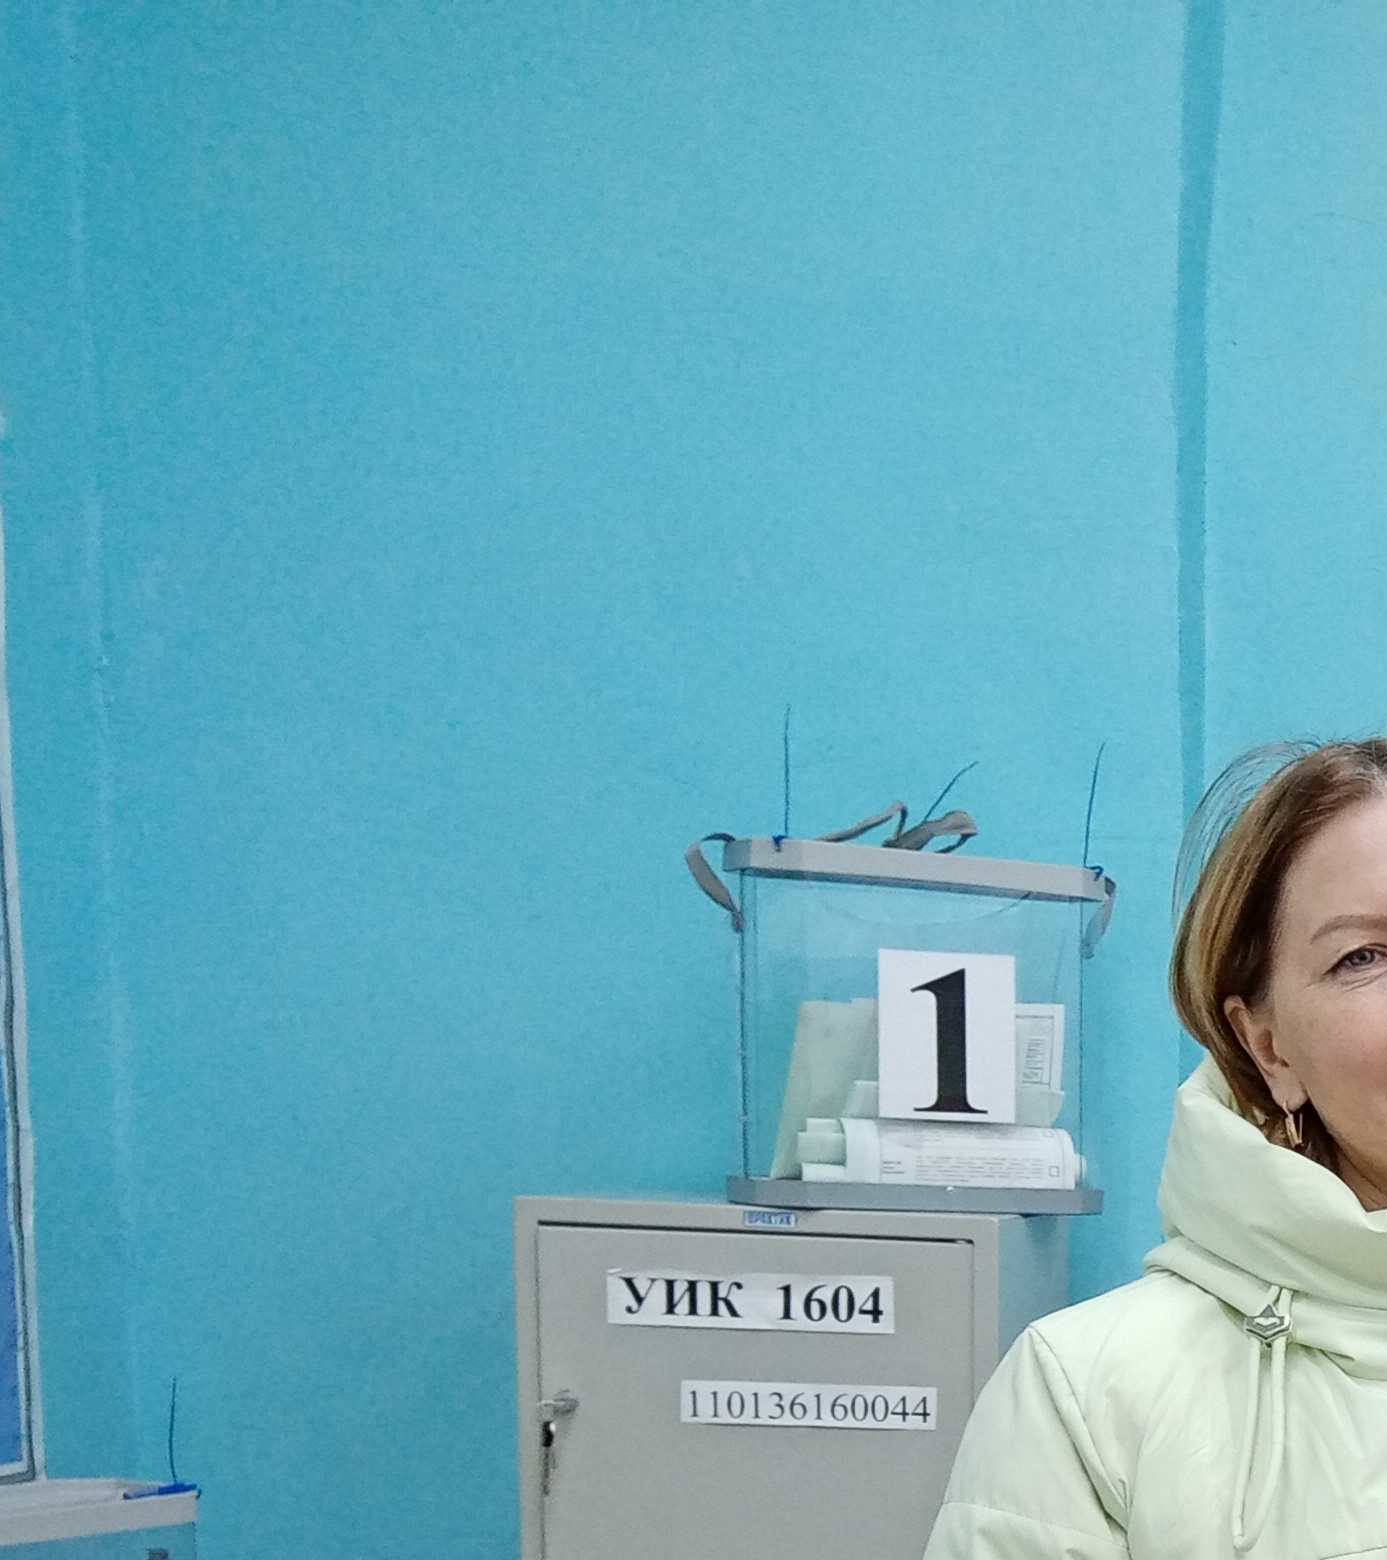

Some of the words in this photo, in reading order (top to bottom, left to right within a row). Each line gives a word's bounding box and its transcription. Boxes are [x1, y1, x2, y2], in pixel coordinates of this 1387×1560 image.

[909, 967, 988, 1115] 1
[618, 1275, 744, 1318] УИК
[775, 1283, 884, 1324] 1604
[689, 1390, 931, 1423] 110136160044
